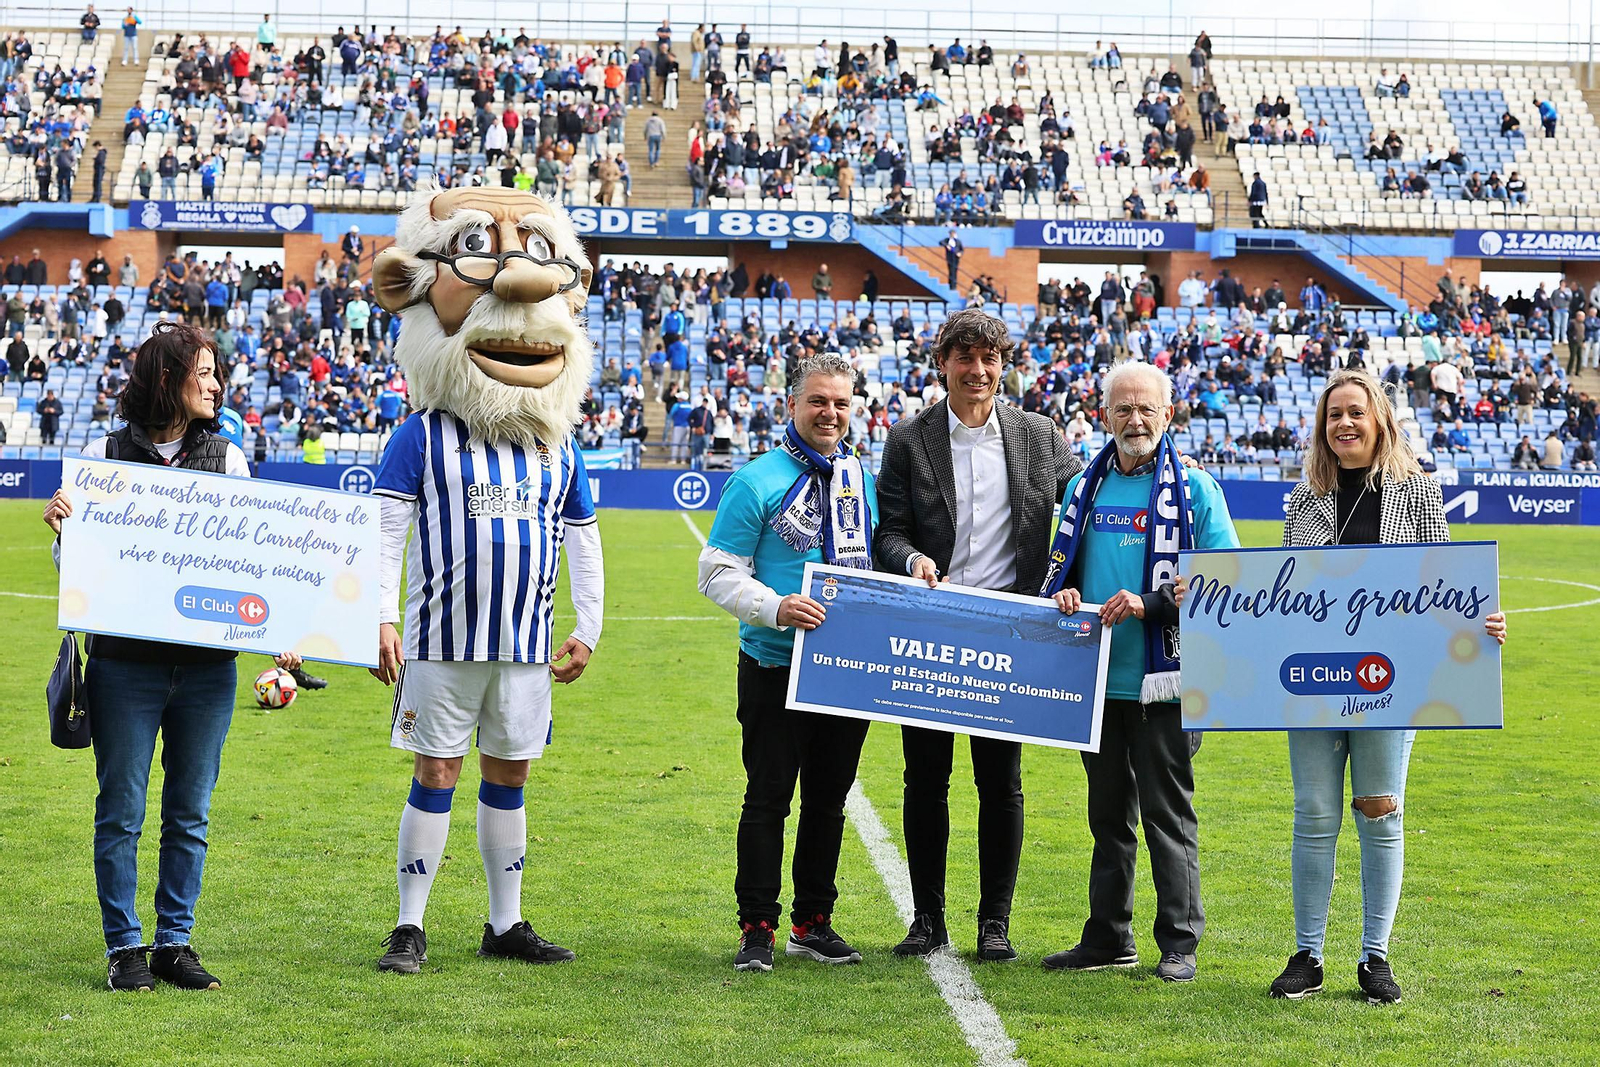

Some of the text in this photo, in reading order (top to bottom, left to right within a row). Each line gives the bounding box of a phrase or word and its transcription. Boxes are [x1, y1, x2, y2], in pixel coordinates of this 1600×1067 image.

[175, 201, 266, 213] HAZTE DONANTE
[177, 212, 265, 223] REGALA VIDA
[572, 208, 828, 239] SDE 1889
[1042, 221, 1165, 249] Cruzcampo
[469, 483, 510, 498] alter
[1474, 472, 1511, 486] PLAN
[1513, 476, 1528, 487] de
[1530, 474, 1600, 488] IGUALDAD
[75, 467, 370, 525] Únete a nuestras comunidades de
[469, 498, 538, 514] enersun
[1508, 494, 1575, 517] Veyser
[1095, 513, 1131, 525] El Club
[82, 501, 362, 565] Facebook El Club Carrefour y
[838, 545, 866, 554] DECANO
[119, 545, 326, 587] vive experiencias únicas
[183, 596, 235, 613] El Club
[1188, 556, 1490, 636] Muchas gracias
[223, 624, 267, 641] ¿Vienes?
[889, 636, 1013, 673] VALE POR
[812, 653, 1083, 703] Un tour por el Estadio Nuevo Colombino
[1290, 666, 1352, 683] El Club
[891, 678, 1001, 705] para 2 personas
[1340, 693, 1393, 718] ¿Vienes?
